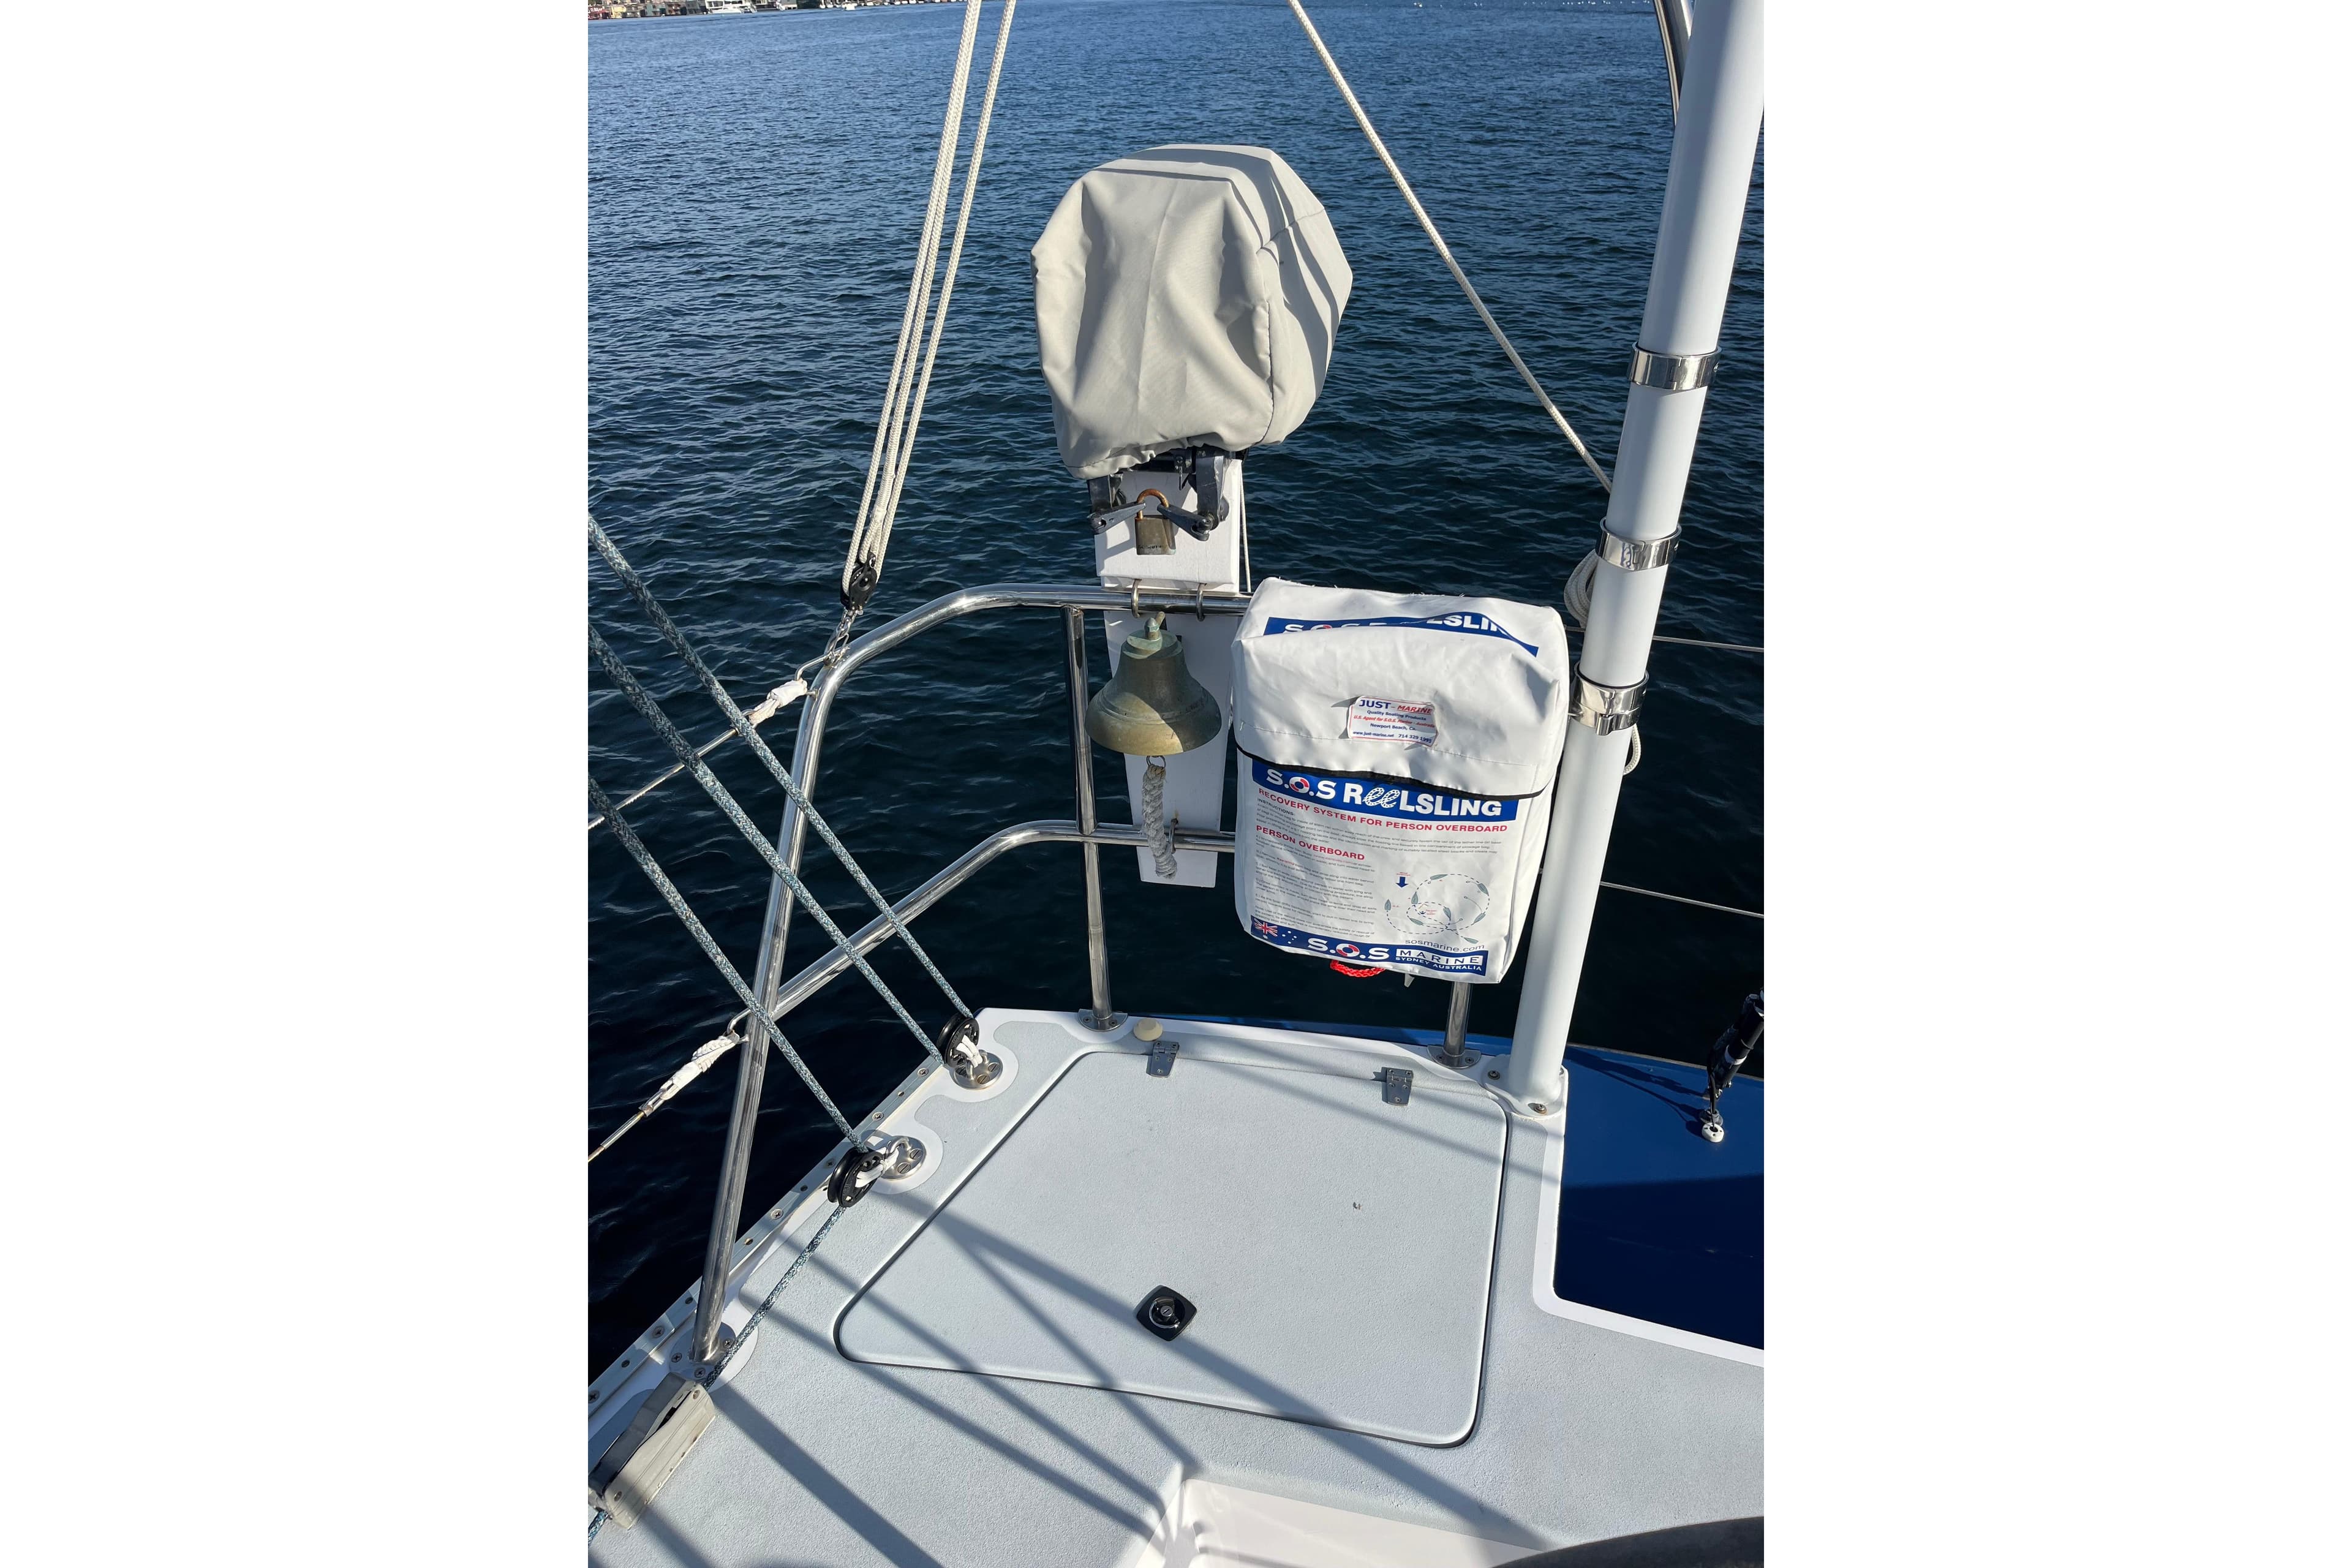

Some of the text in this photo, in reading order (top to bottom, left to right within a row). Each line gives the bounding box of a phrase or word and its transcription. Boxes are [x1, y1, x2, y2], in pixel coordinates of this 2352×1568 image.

[1396, 705, 1433, 714] MARINE
[1259, 788, 1311, 811] RECOVERY
[1313, 807, 1356, 823] SYSTEM
[1360, 817, 1382, 827] FOR
[1386, 821, 1432, 831] PERSON
[1256, 825, 1296, 844] PERSON
[1298, 840, 1365, 860] OVERBOARD
[1308, 937, 1390, 960] S.O.S
[1405, 940, 1485, 952] sosmarine.com
[1400, 950, 1480, 964] MARINE
